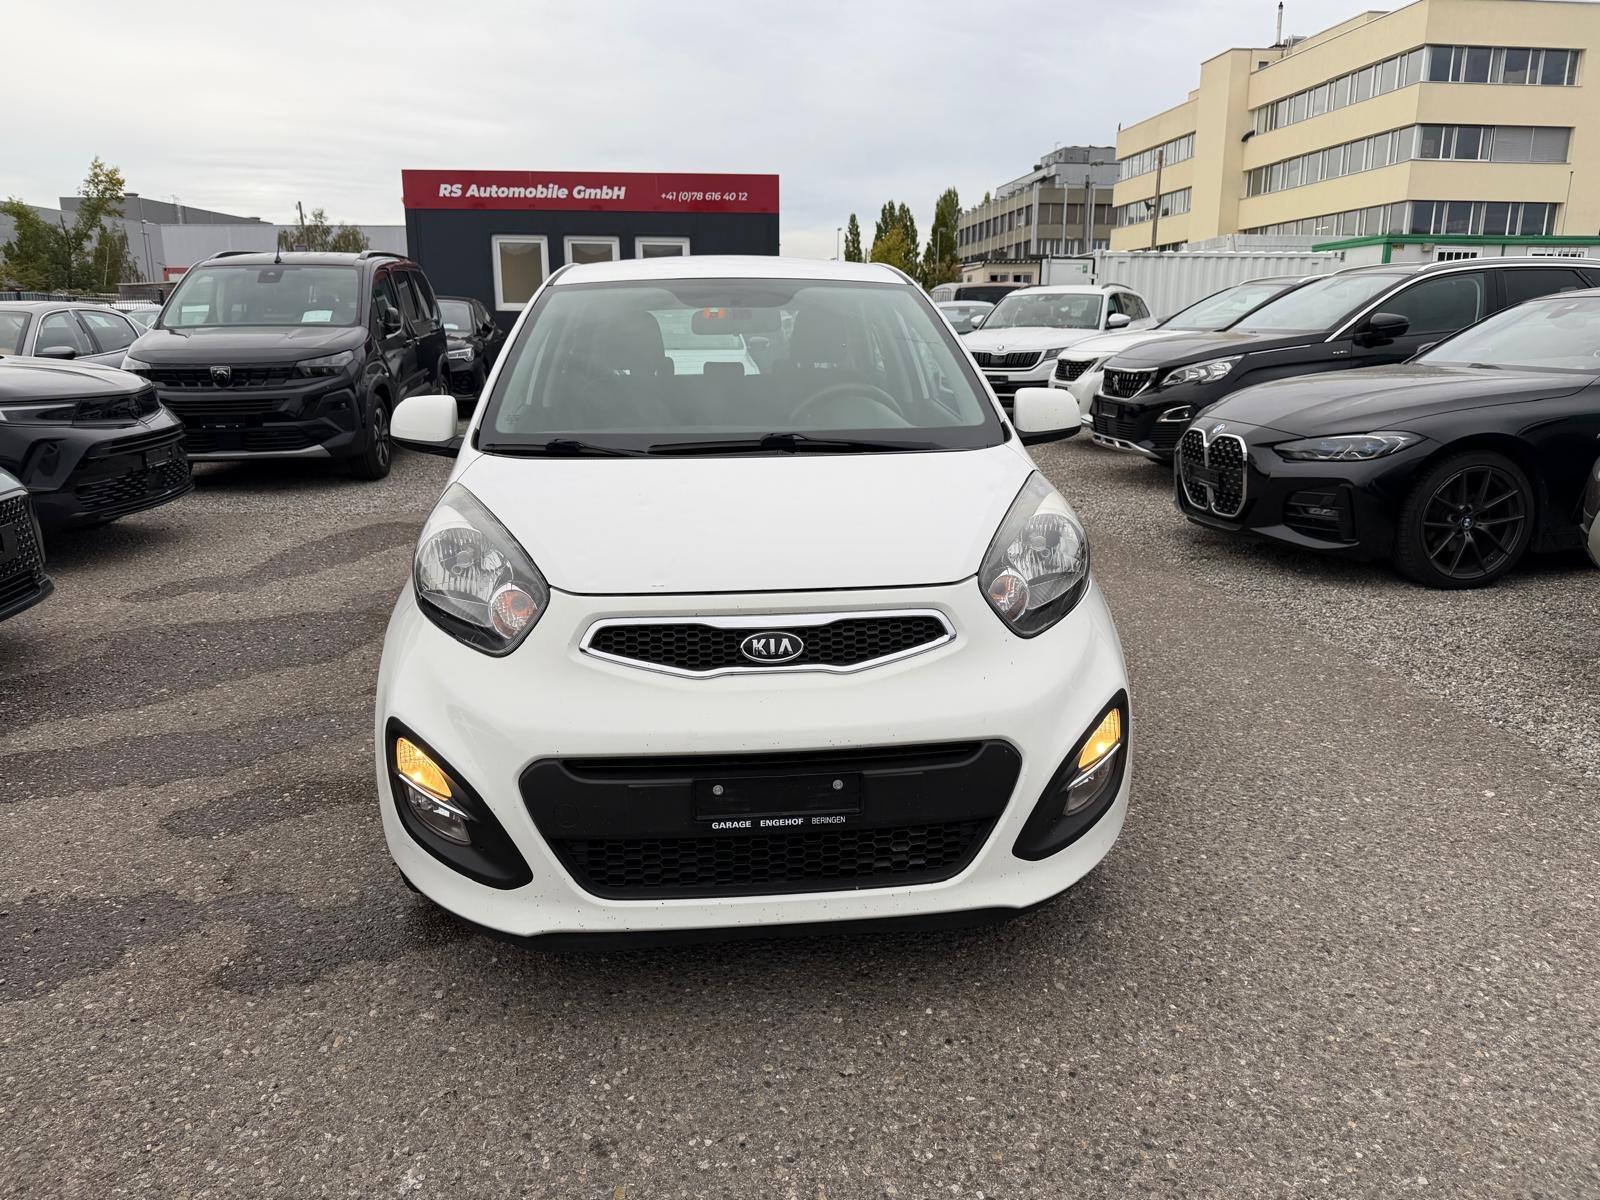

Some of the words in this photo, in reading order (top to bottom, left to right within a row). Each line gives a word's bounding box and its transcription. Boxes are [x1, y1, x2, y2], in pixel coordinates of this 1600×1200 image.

[439, 183, 462, 197] RS
[465, 183, 568, 199] Automobile
[572, 185, 626, 199] GmbH
[661, 192, 676, 201] +41
[678, 191, 703, 202] (0)78
[705, 191, 721, 201] 616
[722, 192, 736, 201] 40
[738, 192, 748, 201] 12
[752, 638, 793, 656] KIA
[711, 820, 752, 829] GARAGE
[760, 818, 804, 827] ENGEHOF
[811, 815, 846, 825] BERINGEN
